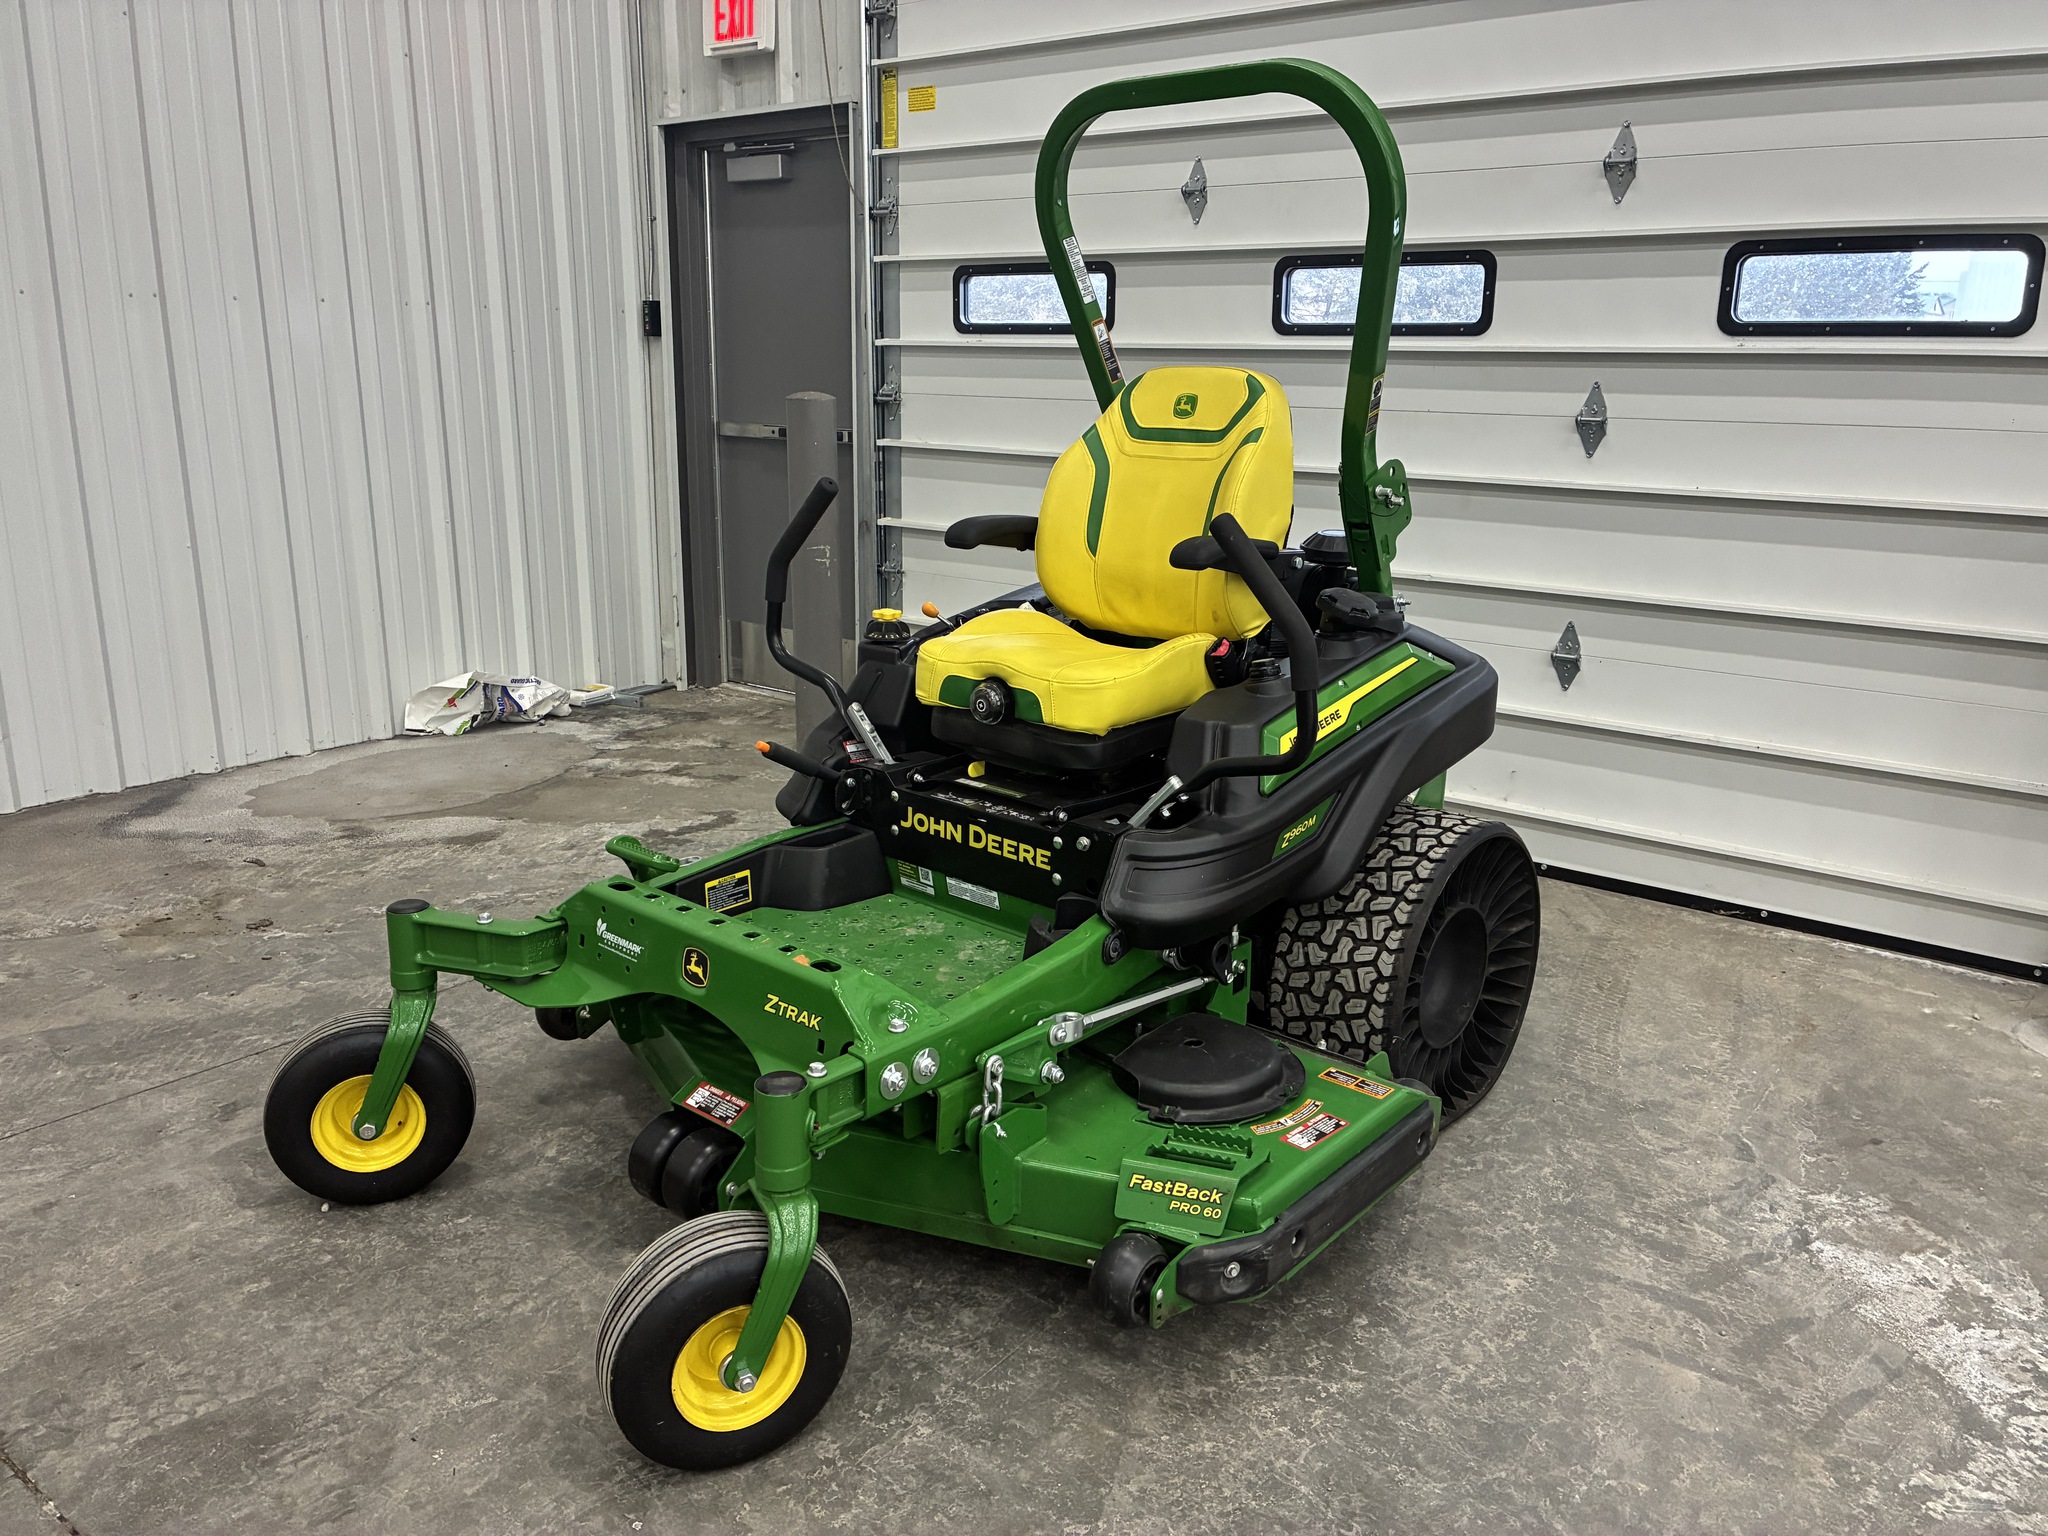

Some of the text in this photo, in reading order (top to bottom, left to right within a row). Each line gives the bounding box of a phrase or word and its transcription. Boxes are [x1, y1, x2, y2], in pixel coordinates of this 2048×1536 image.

[714, 0, 754, 42] EXIT
[900, 805, 962, 845] JOHN
[968, 823, 1051, 871] DEERE
[1281, 814, 1317, 848] Z960M
[602, 930, 642, 954] GREENMARK
[763, 993, 823, 1031] ZTRAK
[1129, 1173, 1224, 1205] FastBack
[1168, 1200, 1223, 1220] PRO 60
